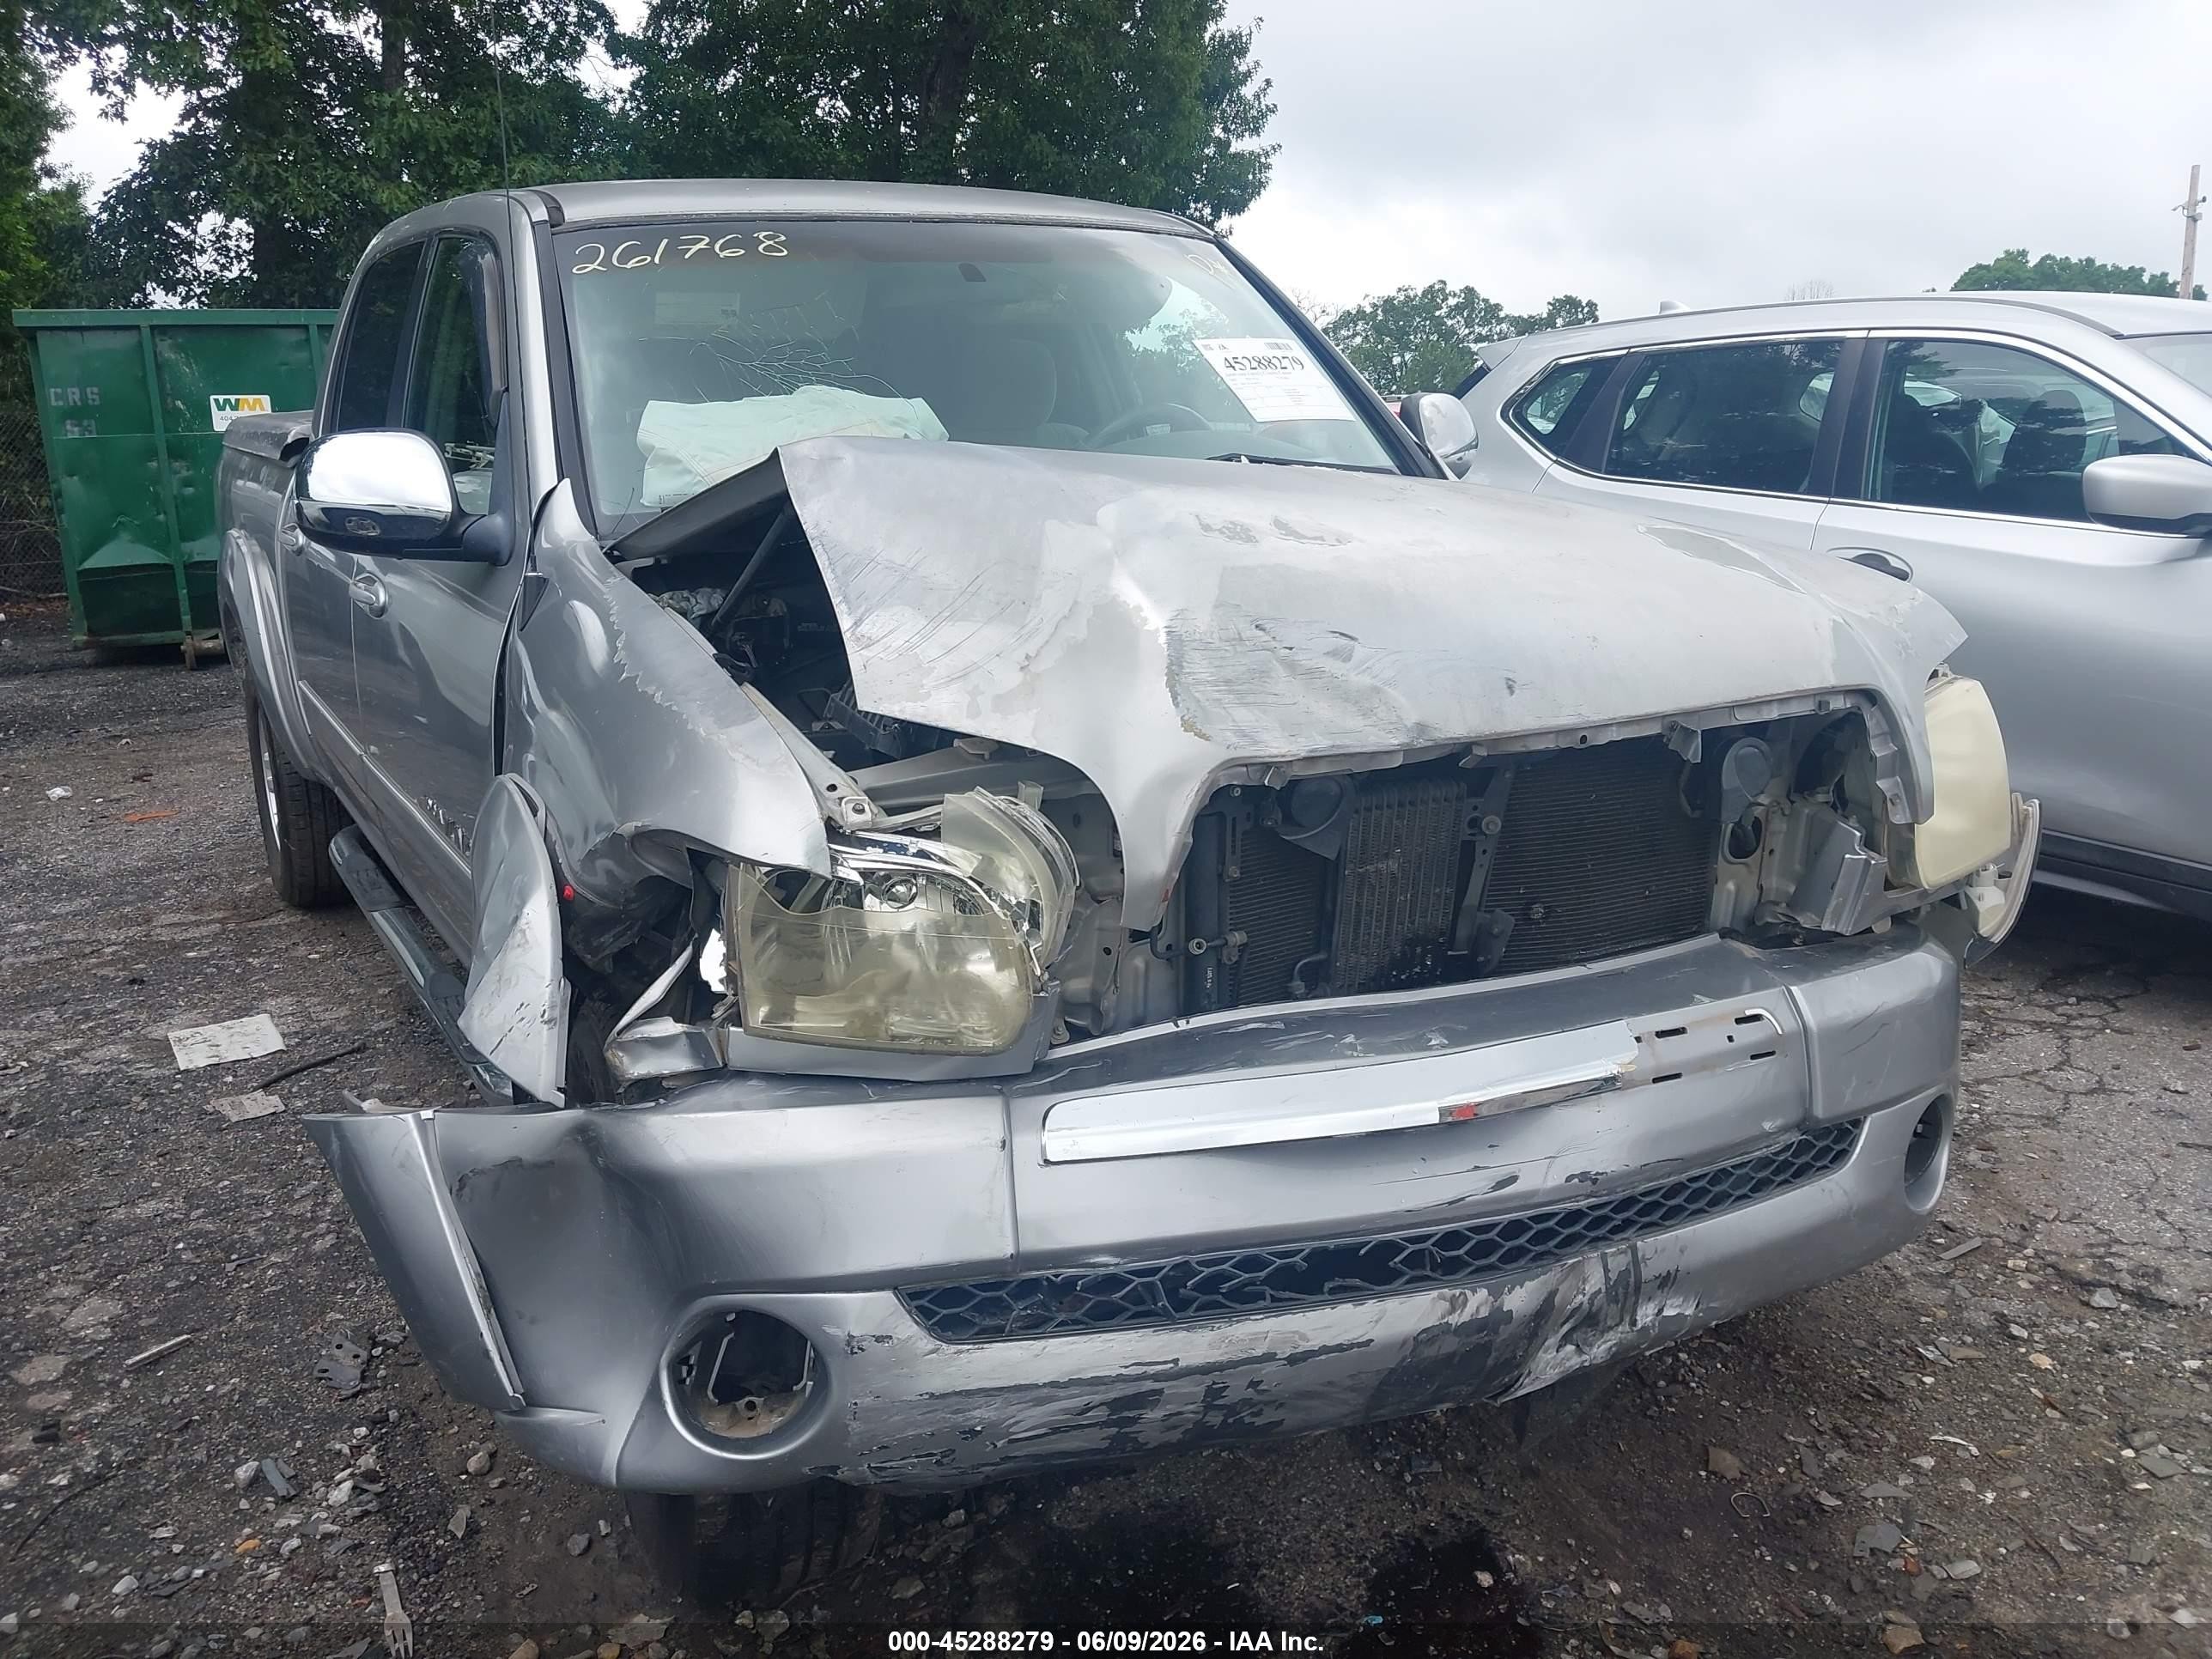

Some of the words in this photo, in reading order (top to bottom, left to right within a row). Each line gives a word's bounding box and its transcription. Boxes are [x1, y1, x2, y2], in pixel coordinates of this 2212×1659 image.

[571, 231, 788, 274] 261768
[1224, 355, 1304, 372] 45288279
[49, 386, 100, 406] CRS
[213, 398, 265, 411] WM
